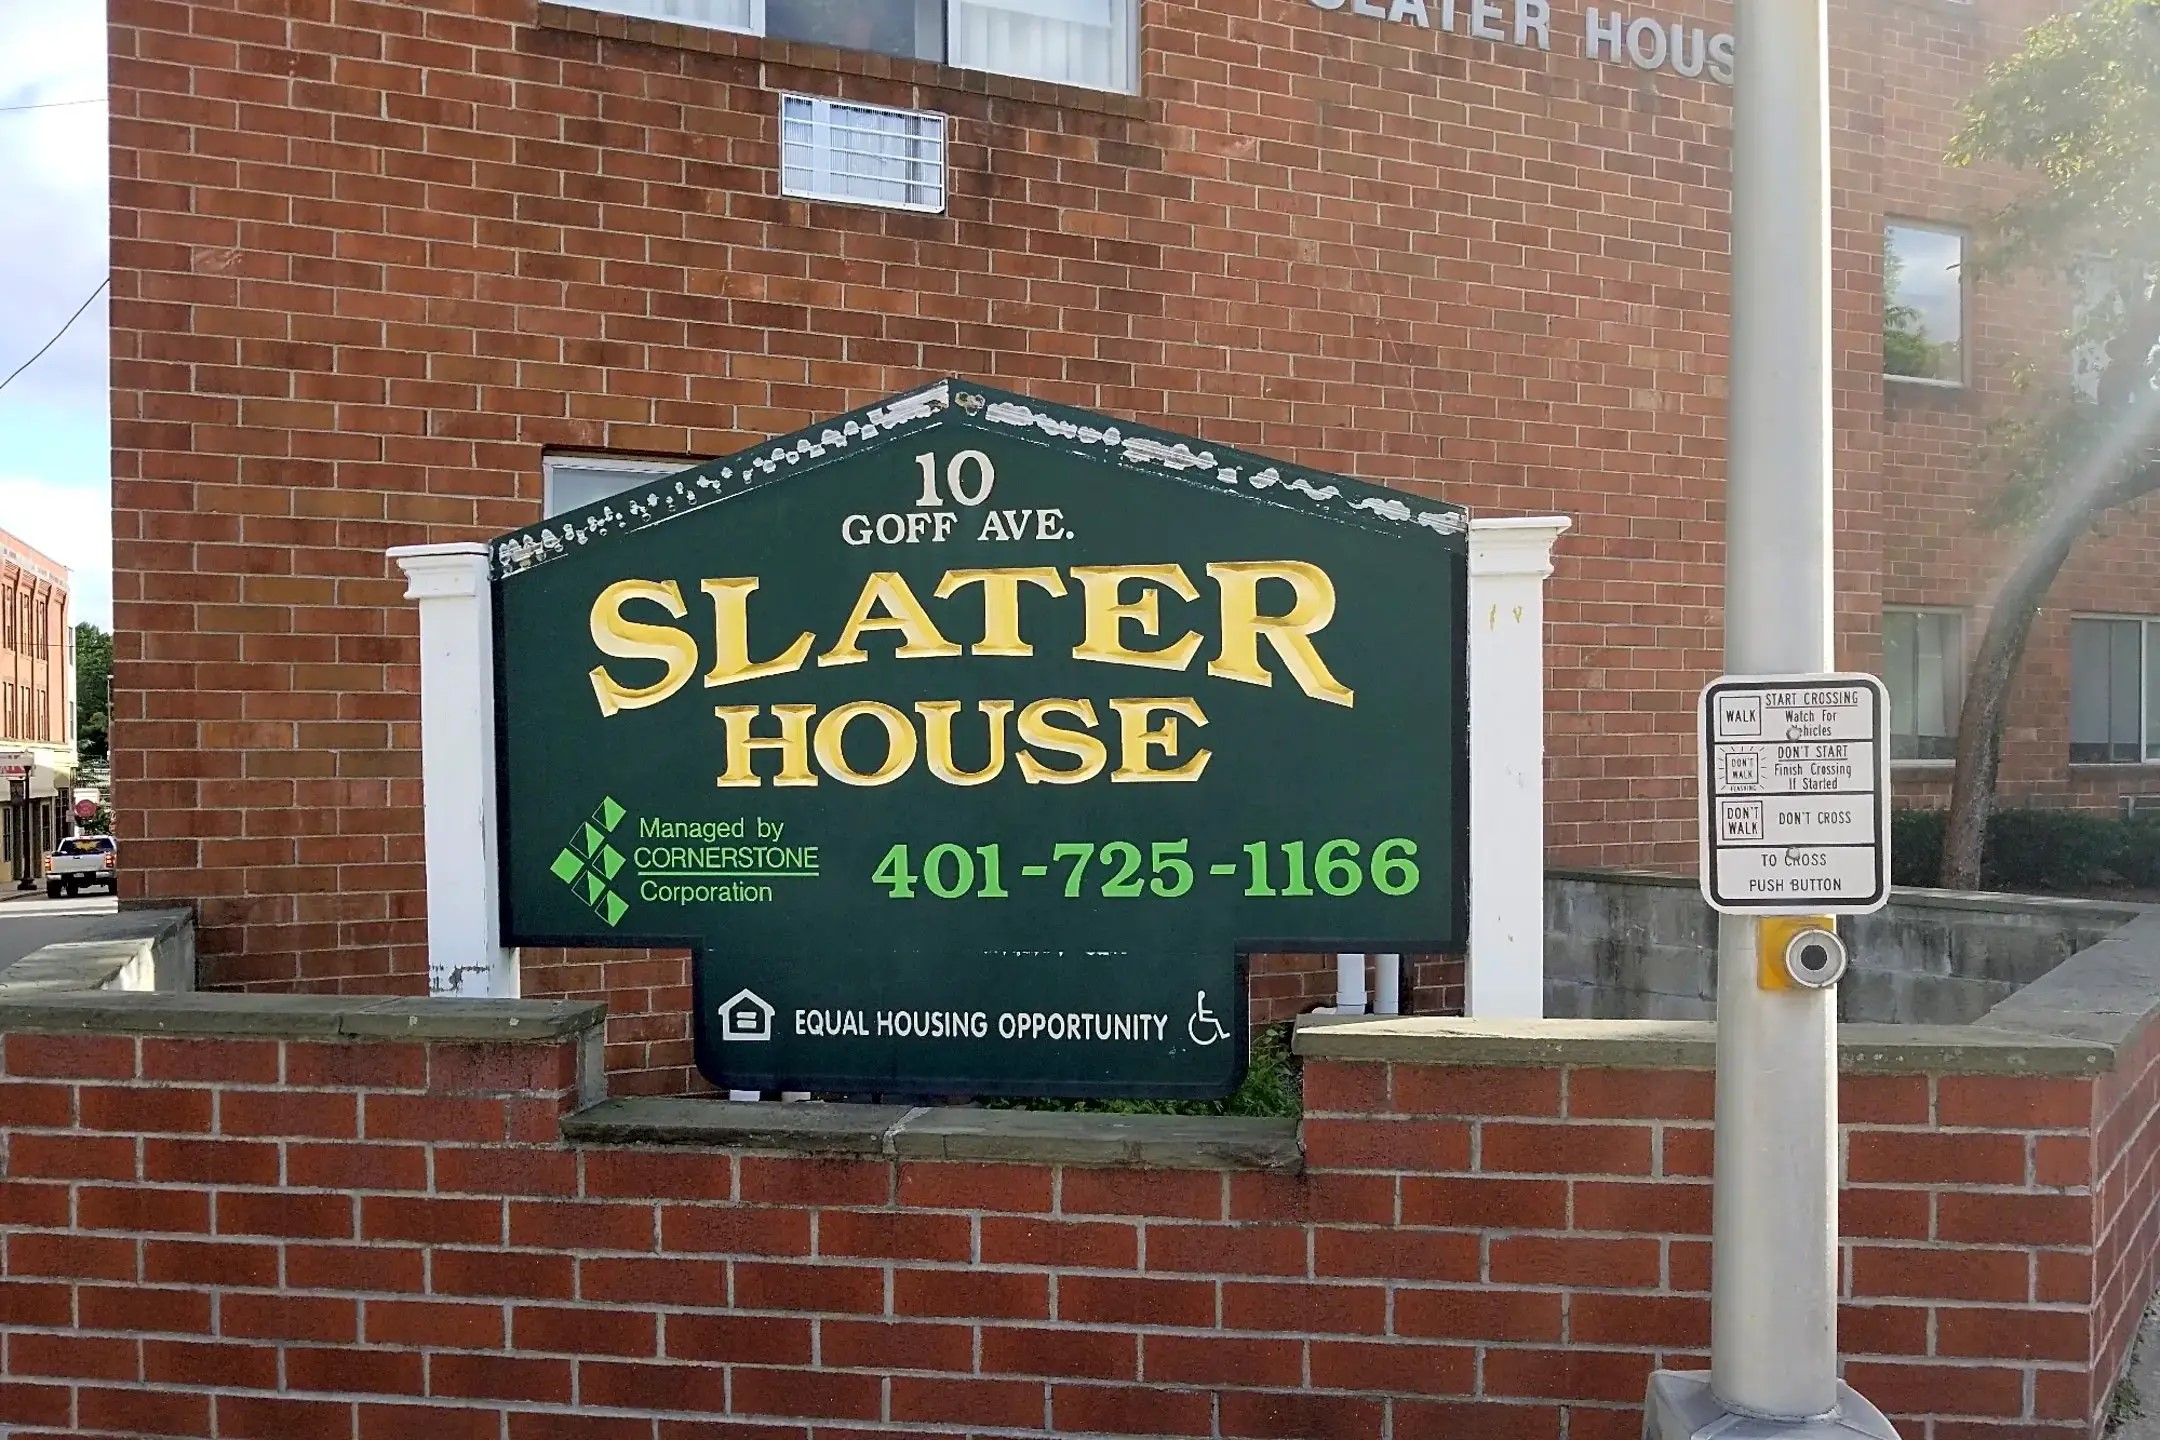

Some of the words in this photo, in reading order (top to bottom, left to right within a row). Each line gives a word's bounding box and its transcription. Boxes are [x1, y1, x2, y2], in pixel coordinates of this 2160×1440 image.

[1310, 0, 1551, 51] ATER
[1584, 7, 1736, 86] HOUS
[915, 449, 995, 507] 10
[842, 512, 958, 546] GOFF
[977, 508, 1075, 541] AVE.
[589, 559, 1355, 718] SLATER
[1765, 692, 1797, 706] START
[1803, 691, 1859, 705] CROSSING
[1726, 709, 1756, 723] WALK
[1785, 709, 1815, 723] Watch
[1822, 709, 1837, 722] For
[1791, 723, 1832, 737] ehicles
[714, 696, 1213, 788] HOUSE
[1778, 746, 1809, 759] DON'T
[1816, 744, 1849, 758] START
[1731, 757, 1754, 768] DON'T
[1732, 769, 1753, 780] WALK
[1774, 763, 1803, 776] Finish
[1810, 763, 1852, 778] Crossing
[1789, 778, 1797, 790] If
[1803, 778, 1838, 790] Started
[1727, 806, 1759, 820] DON'T
[1779, 812, 1811, 825] DON'T
[1818, 811, 1852, 825] CROSS
[639, 817, 744, 843] Managed
[757, 816, 785, 843] by
[1728, 821, 1759, 835] WALK
[633, 846, 820, 869] CORNERSTONE
[1761, 853, 1777, 867] TO
[1749, 878, 1784, 892] PUSH
[1791, 877, 1842, 891] BUTTON
[640, 881, 773, 906] Corporation
[795, 1009, 869, 1037] EQUAL
[877, 1011, 988, 1039] HOUSING
[998, 1012, 1169, 1041] OPPORTUNITY
